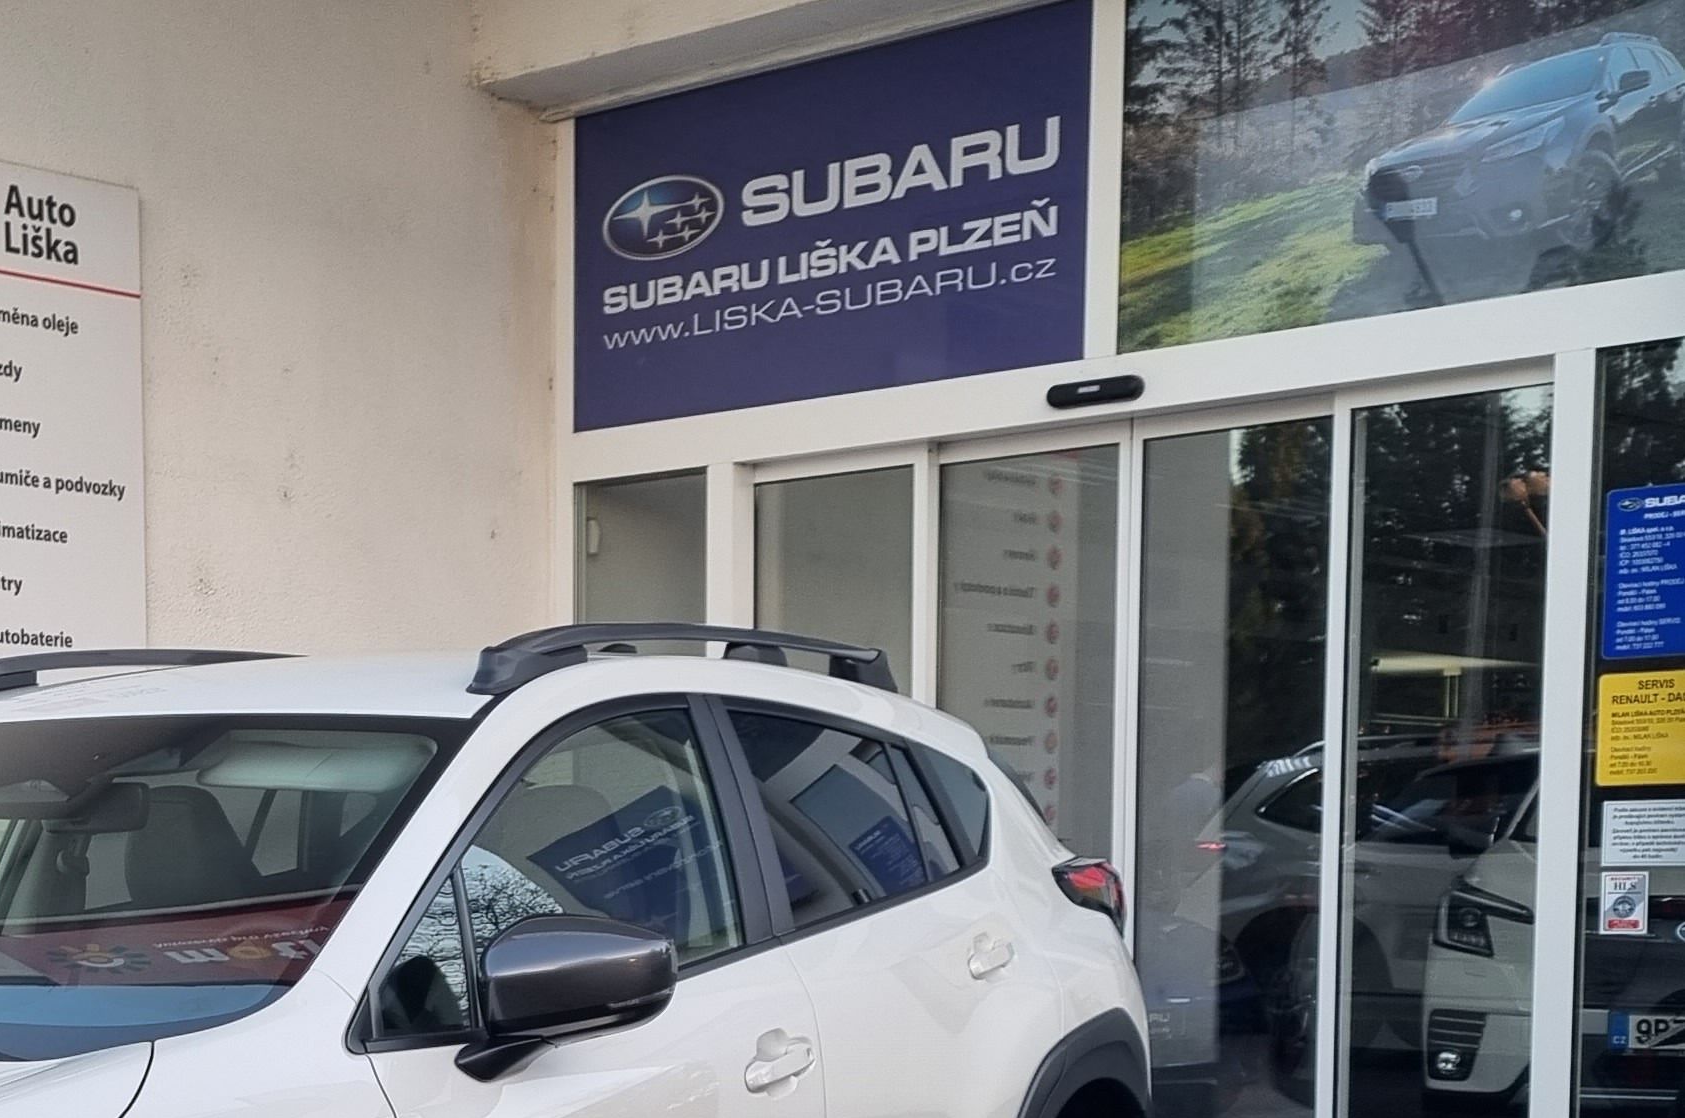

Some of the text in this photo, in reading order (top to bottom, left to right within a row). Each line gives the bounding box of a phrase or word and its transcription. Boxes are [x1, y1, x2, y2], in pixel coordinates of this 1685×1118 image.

[741, 115, 1062, 228] SUBARU
[4, 184, 76, 228] Auto
[5, 221, 78, 265] Liška
[602, 198, 1058, 316] SUBARU LIŠKA PLZEŇ
[602, 257, 1057, 351] www.LISKA-SUBARU.cz
[42, 313, 78, 337] oleje
[43, 475, 52, 489] a
[55, 476, 126, 501] podvozky
[1612, 693, 1659, 705] RENAULT
[1637, 679, 1675, 690] SERVIS
[1612, 1035, 1627, 1044] CZ
